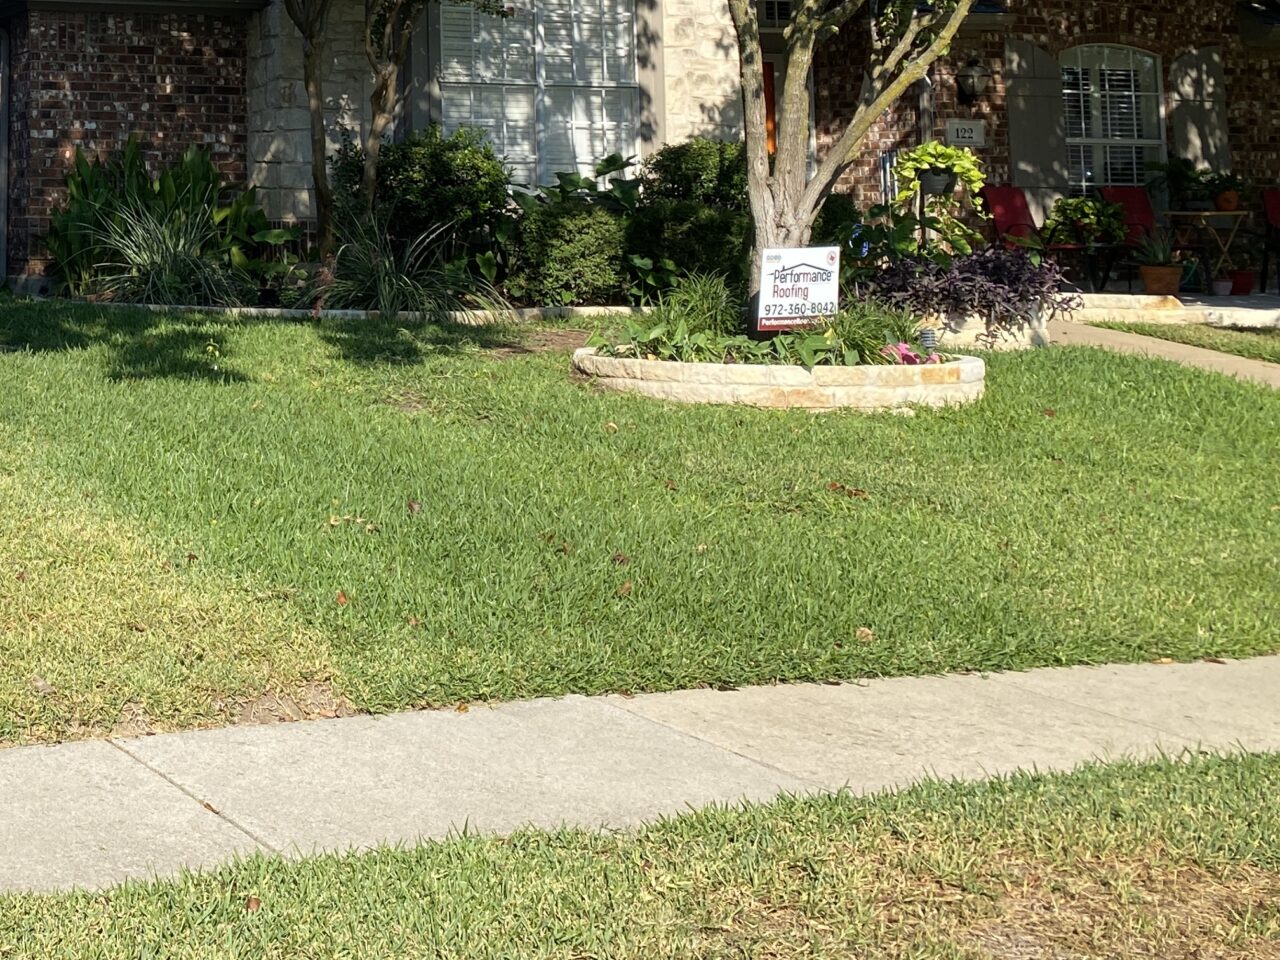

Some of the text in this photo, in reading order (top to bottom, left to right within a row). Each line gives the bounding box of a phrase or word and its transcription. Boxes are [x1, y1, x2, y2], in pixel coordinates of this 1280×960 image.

[955, 127, 974, 139] 122
[773, 269, 832, 283] Performance
[773, 284, 809, 300] Roofing
[764, 301, 835, 316] 972-360-8042
